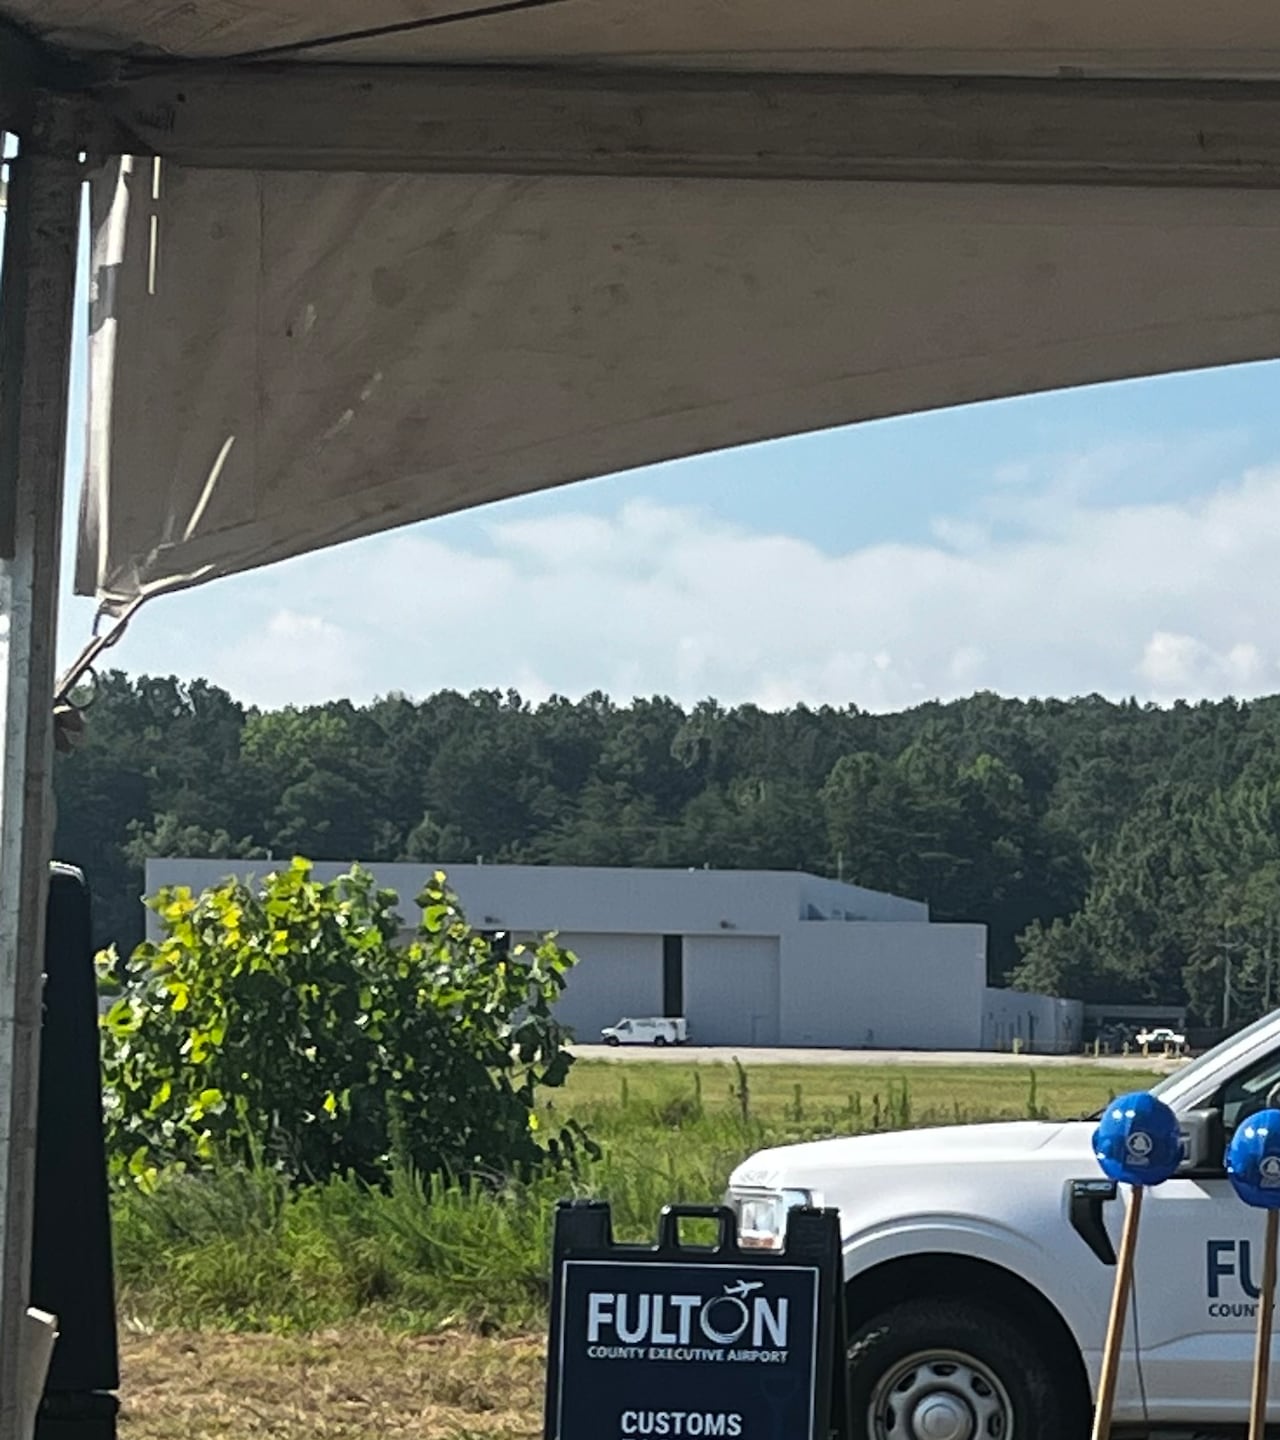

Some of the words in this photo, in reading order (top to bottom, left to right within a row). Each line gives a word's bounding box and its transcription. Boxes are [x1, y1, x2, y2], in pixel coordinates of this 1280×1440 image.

[586, 1291, 788, 1347] FULTON
[587, 1346, 647, 1360] COUNTY
[649, 1347, 725, 1362] EXECUTIVE
[727, 1349, 789, 1363] AIRPORT
[621, 1411, 742, 1437] CUSTOMS
